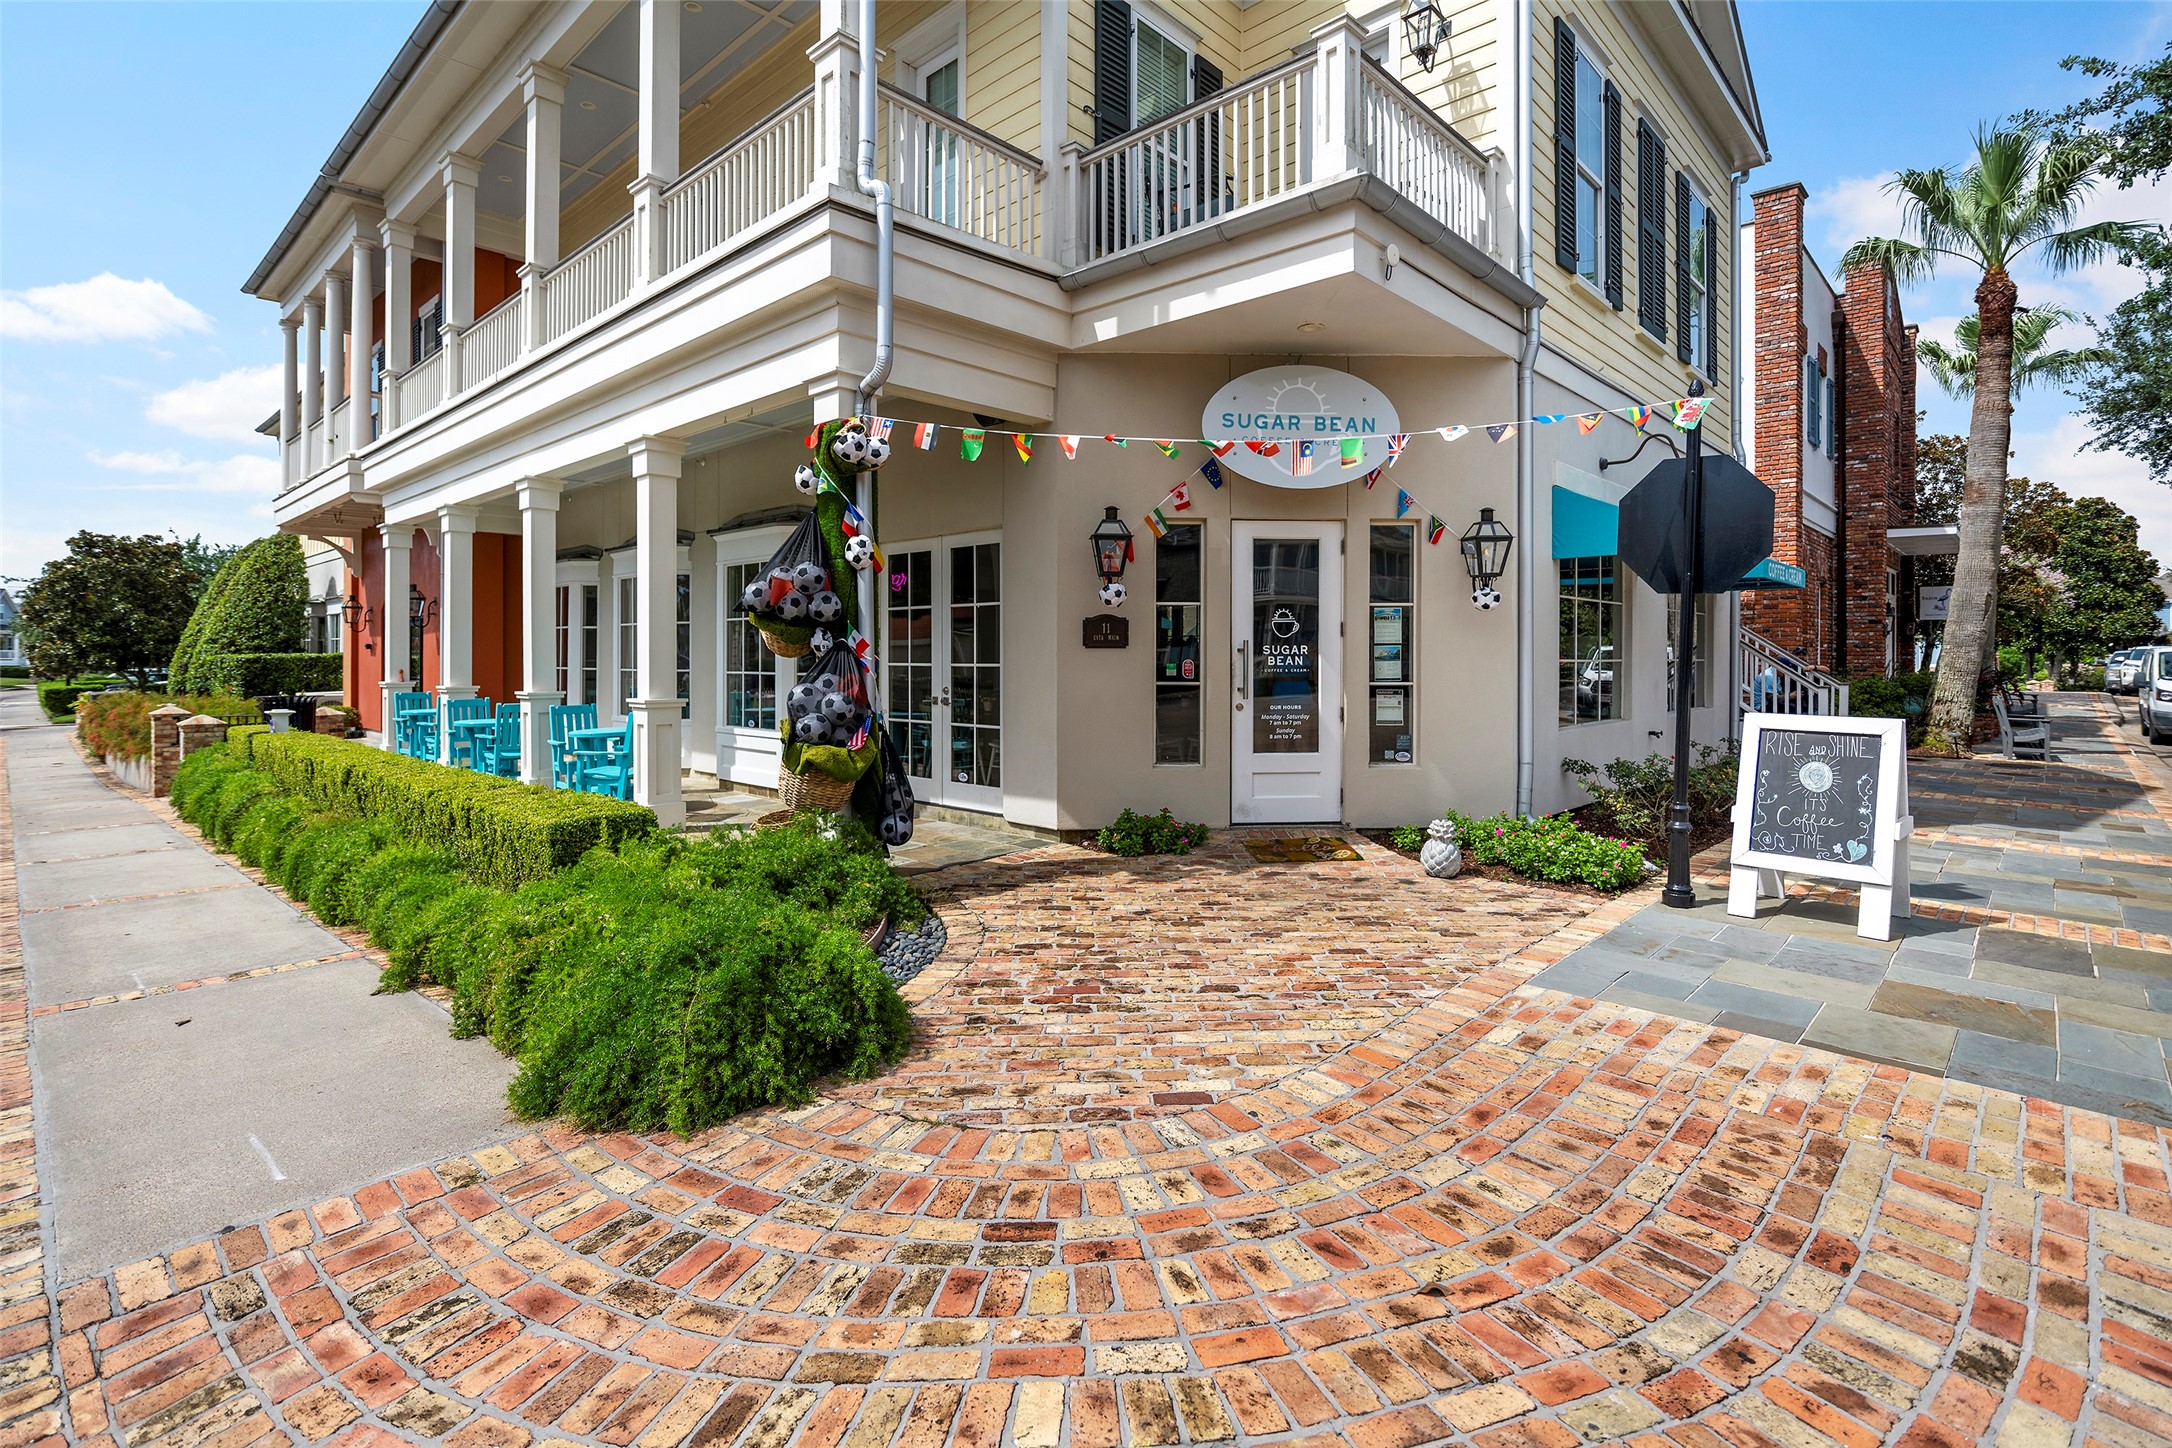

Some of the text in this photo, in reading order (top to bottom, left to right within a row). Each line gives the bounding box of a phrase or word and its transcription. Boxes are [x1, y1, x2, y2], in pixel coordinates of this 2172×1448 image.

[1222, 412, 1376, 433] SUGAR BEAN
[1768, 562, 1786, 581] COFFEE
[1788, 568, 1802, 584] CREAM
[1102, 622, 1110, 634] 11
[1262, 645, 1308, 655] SUGAR
[1267, 656, 1303, 666] BEAN
[1286, 713, 1310, 721] Saturday
[1276, 727, 1296, 735] Sunday
[1765, 730, 1874, 759] RISE AND SHINE
[1776, 805, 1845, 834] Coffee
[1791, 833, 1828, 852] TIME
